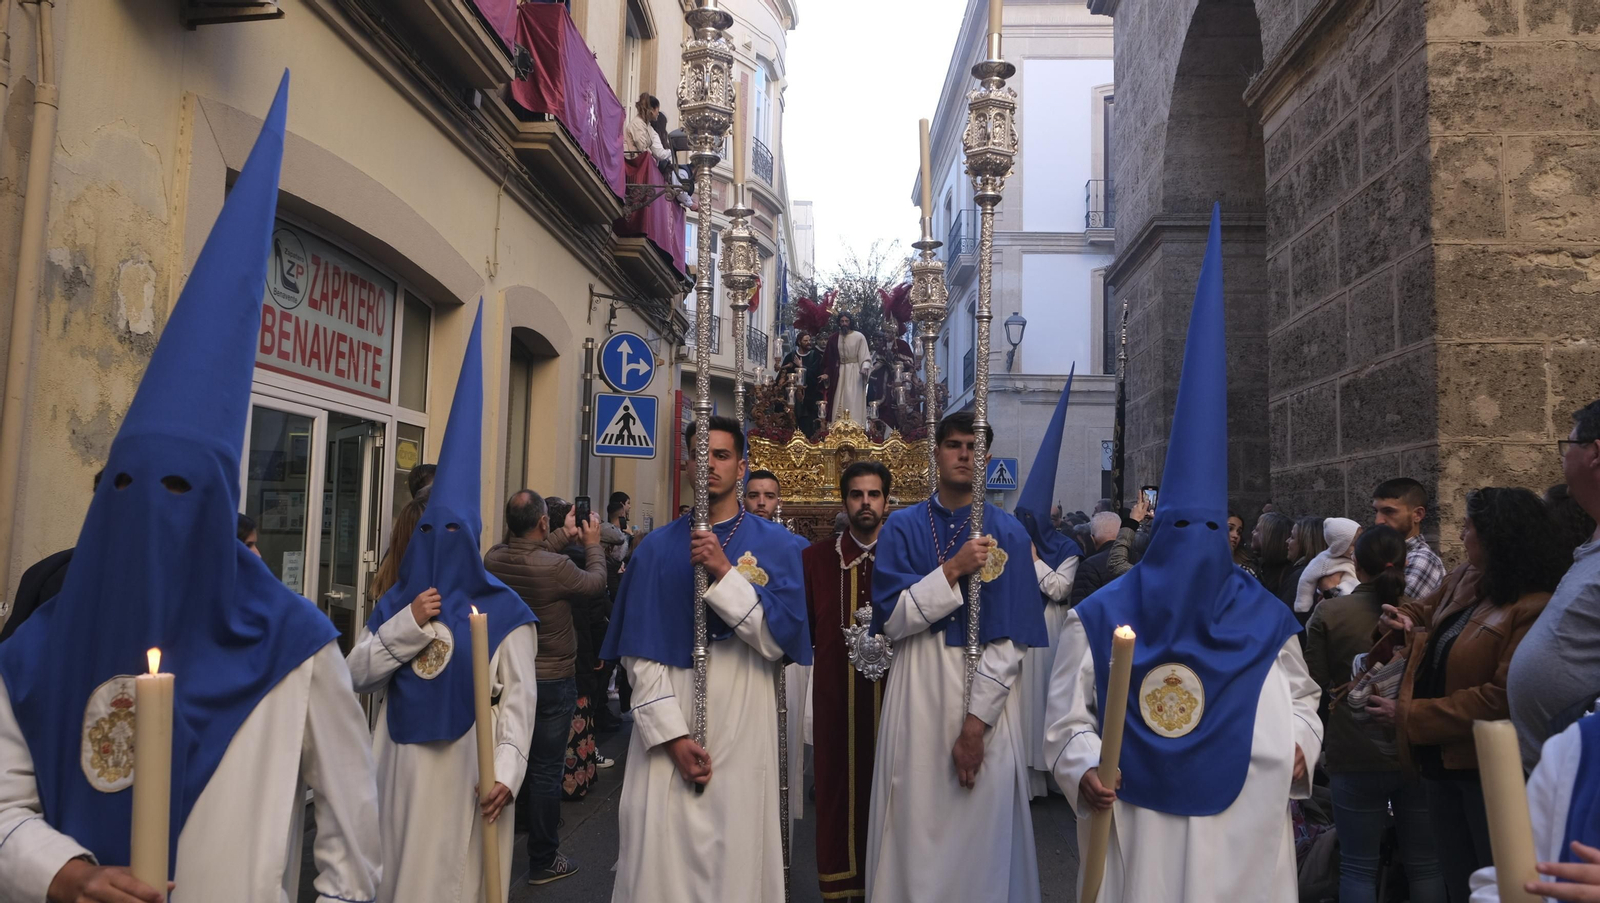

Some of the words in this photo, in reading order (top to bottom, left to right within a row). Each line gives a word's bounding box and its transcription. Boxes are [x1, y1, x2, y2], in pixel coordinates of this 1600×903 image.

[284, 247, 304, 263] Zapatero
[286, 259, 304, 279] ZP
[273, 287, 298, 304] Benavente
[308, 253, 386, 337] ZAPATERO
[259, 304, 383, 389] BENAVENTE
